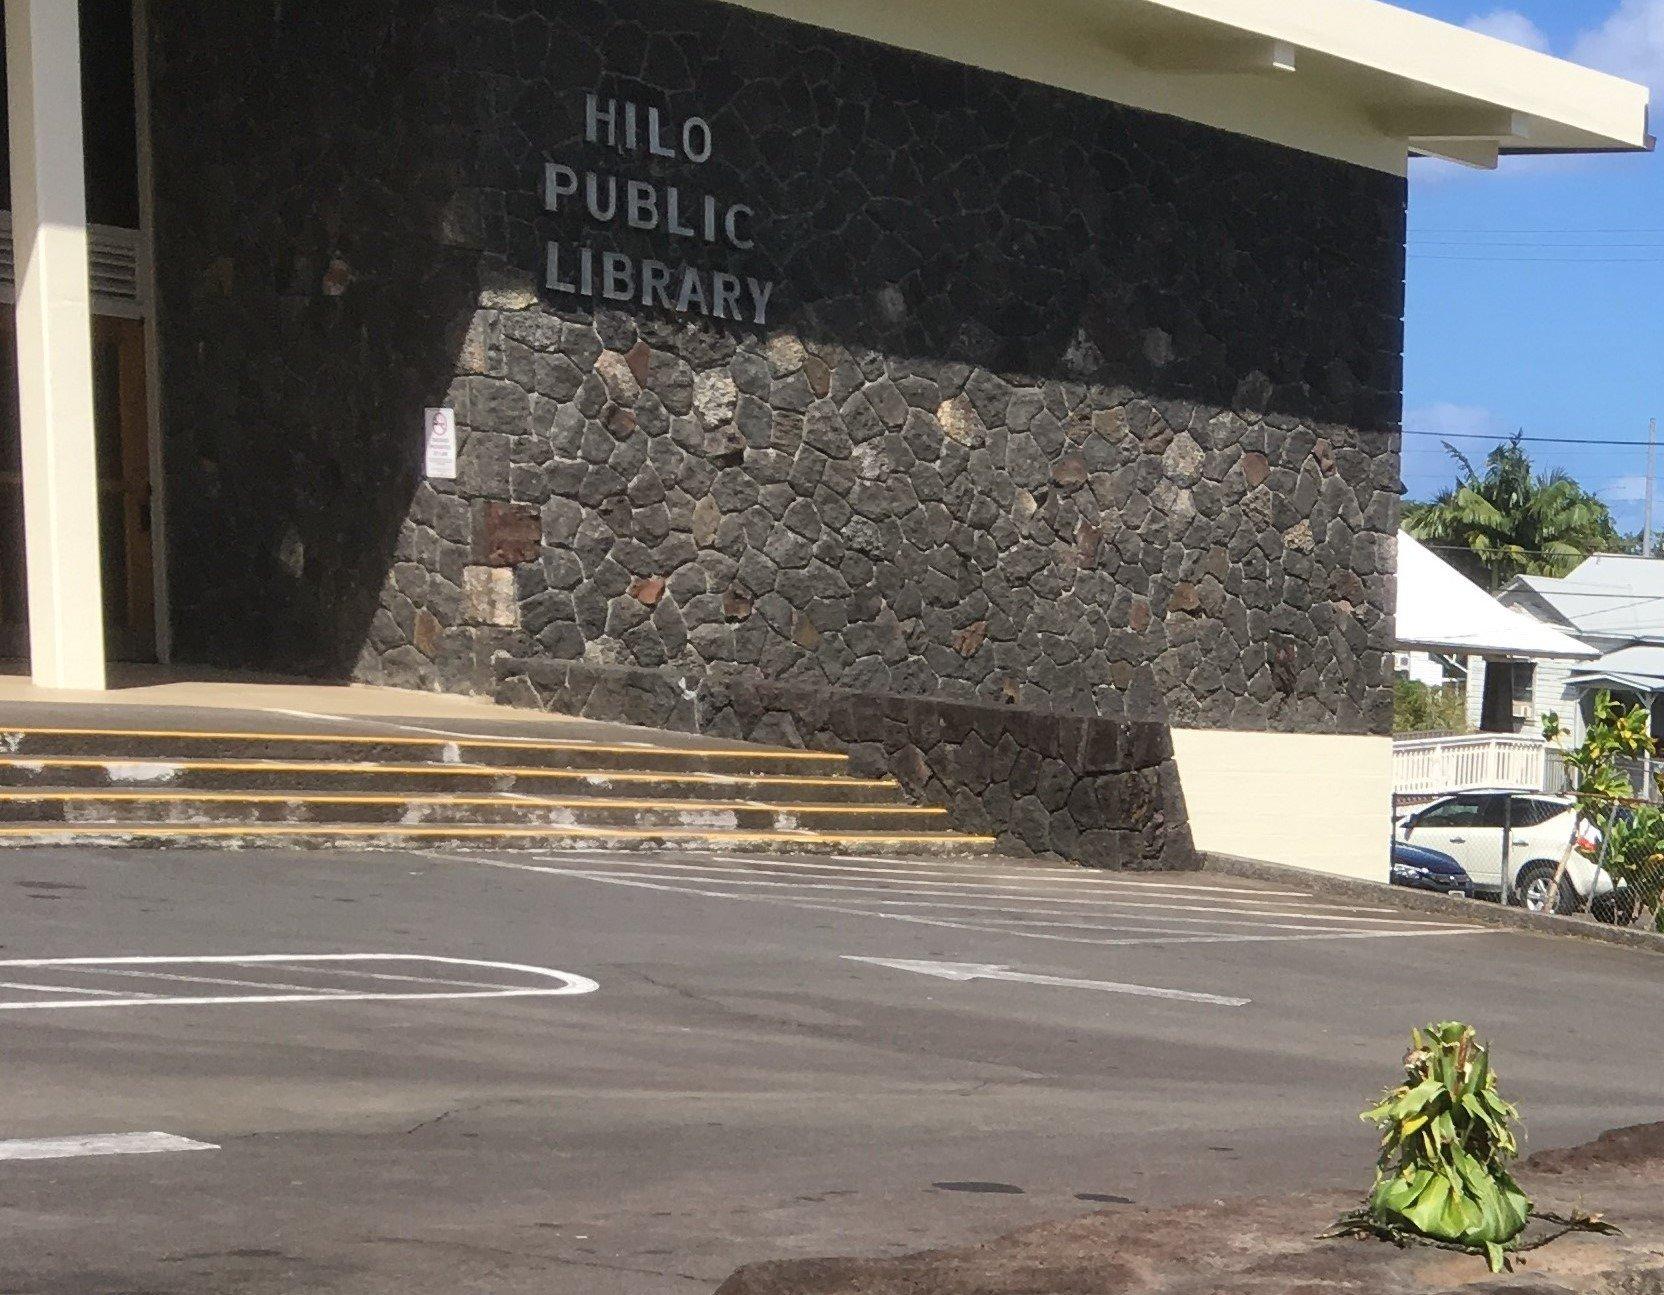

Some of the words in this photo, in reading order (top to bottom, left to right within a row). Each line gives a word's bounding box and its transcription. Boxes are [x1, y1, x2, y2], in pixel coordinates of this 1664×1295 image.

[586, 93, 712, 163] HILO
[545, 162, 755, 249] PUBLIC
[545, 241, 773, 325] LIBRARY
